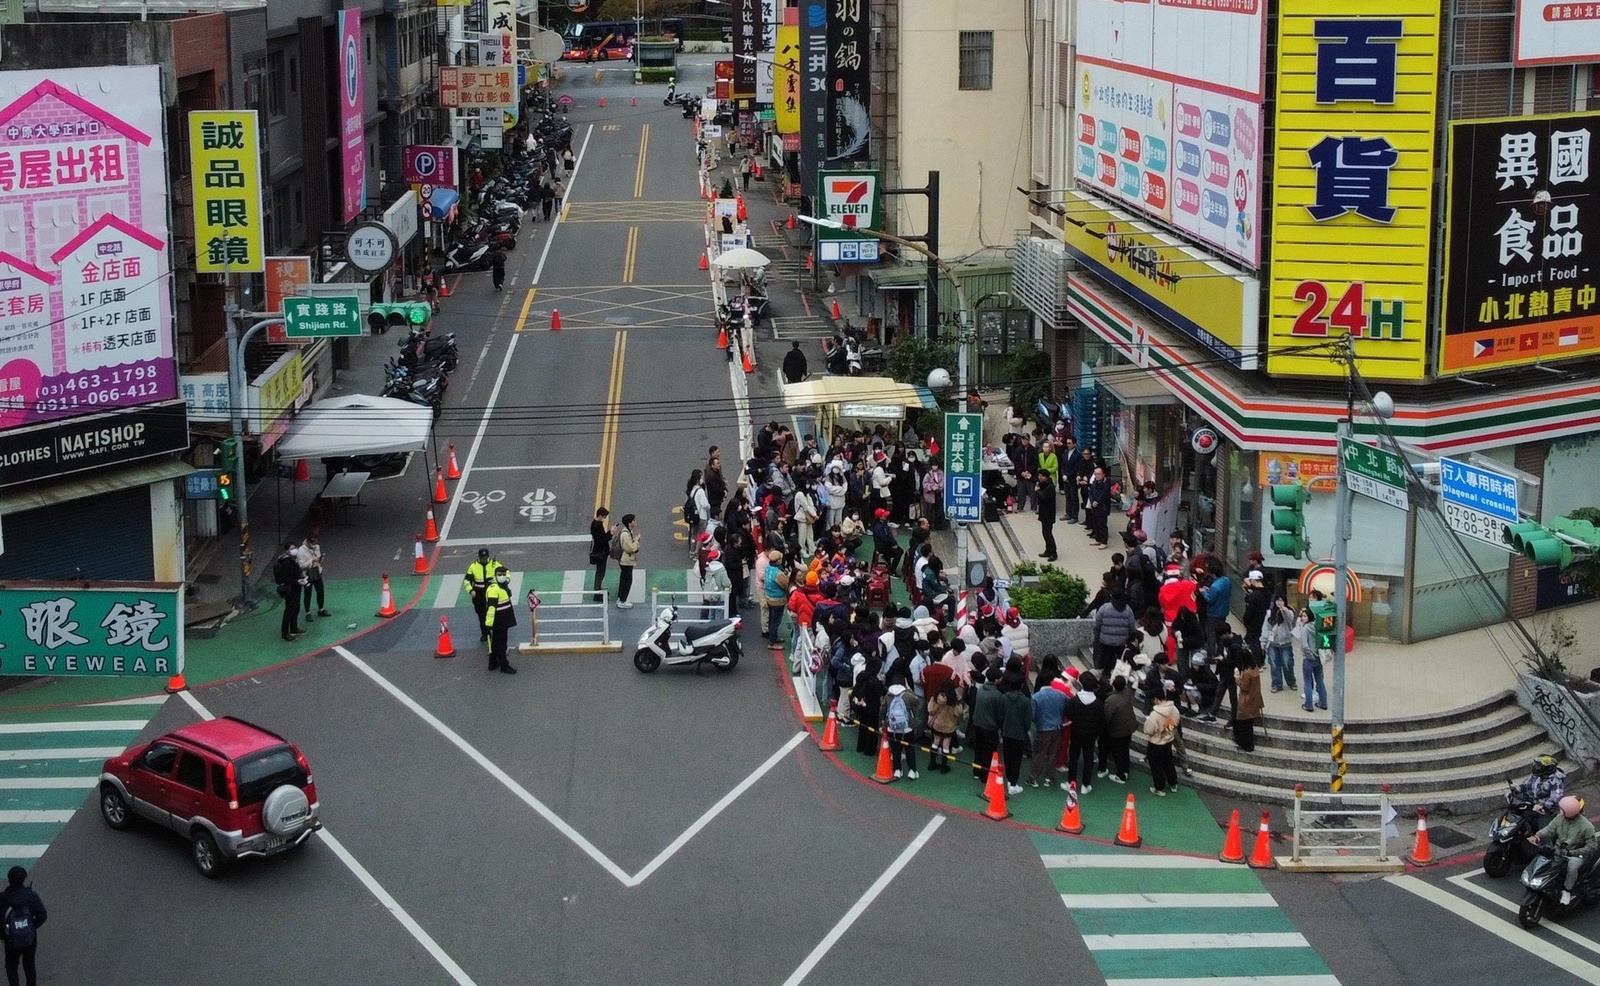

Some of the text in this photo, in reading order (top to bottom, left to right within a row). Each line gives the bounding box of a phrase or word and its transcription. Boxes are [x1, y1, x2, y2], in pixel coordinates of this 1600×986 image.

[461, 72, 510, 89] 夢工場
[460, 91, 511, 103] 數位影像
[7, 121, 100, 139] 中原大學正門口
[1304, 19, 1404, 225] 百貨
[420, 155, 433, 173] P
[1494, 127, 1591, 192] 異國
[201, 120, 250, 266] 誠品眼鏡
[354, 238, 386, 249] 可不可
[1493, 203, 1584, 267] 食品
[81, 257, 141, 284] 金店面
[1502, 265, 1578, 287] Import Food
[80, 287, 127, 307] 1F 店面
[1291, 279, 1404, 340] 24H
[1478, 284, 1597, 324] 小北熱賣中
[81, 307, 151, 330] 1F+2F 店面
[299, 320, 349, 331] Shijian Rd.
[35, 365, 157, 399] (03)463-1798
[36, 381, 158, 415] 0911-066-412
[61, 422, 145, 454] NAFISHOP
[951, 432, 965, 473] 中原大學
[0, 445, 50, 467] CLOTHES
[1348, 444, 1398, 475] 中北路
[957, 479, 970, 494] P
[1442, 463, 1515, 500] 行人專用時相
[947, 505, 979, 518] 停車場
[1442, 484, 1517, 517] Diagonal crossing
[0, 597, 170, 652] 眼鏡
[24, 655, 169, 673] EYEWEAR
